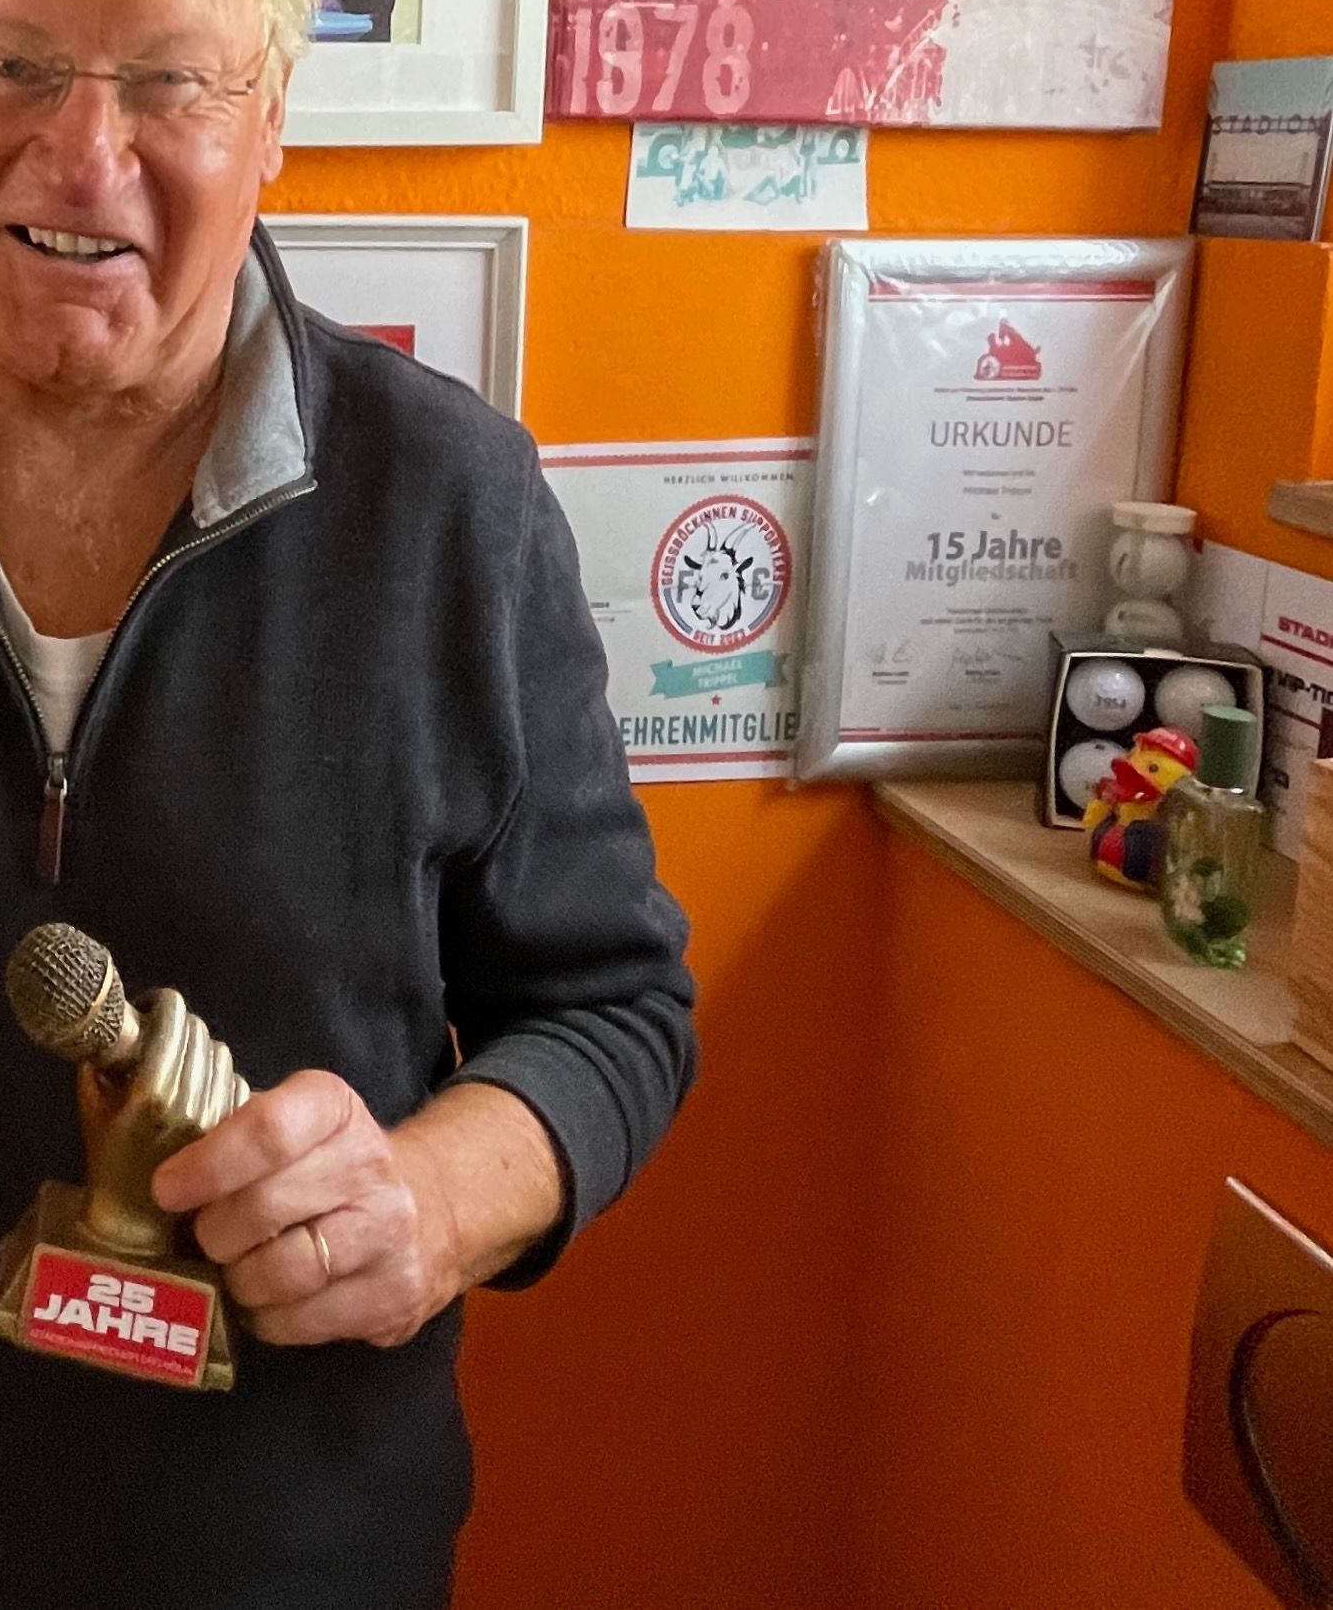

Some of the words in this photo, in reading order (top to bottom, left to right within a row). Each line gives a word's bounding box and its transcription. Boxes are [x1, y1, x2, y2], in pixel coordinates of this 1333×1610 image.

[930, 420, 1075, 448] URKUNDE
[663, 474, 715, 484] HERZLICH
[720, 472, 796, 483] WILLKOMMEN
[927, 531, 965, 561] 15
[971, 528, 1063, 564] Jahre
[905, 559, 1079, 588] Mitgliedschaft
[620, 712, 802, 747] EHRENMITGLIE
[87, 1273, 156, 1314] 25
[33, 1293, 200, 1357] JAHRE
